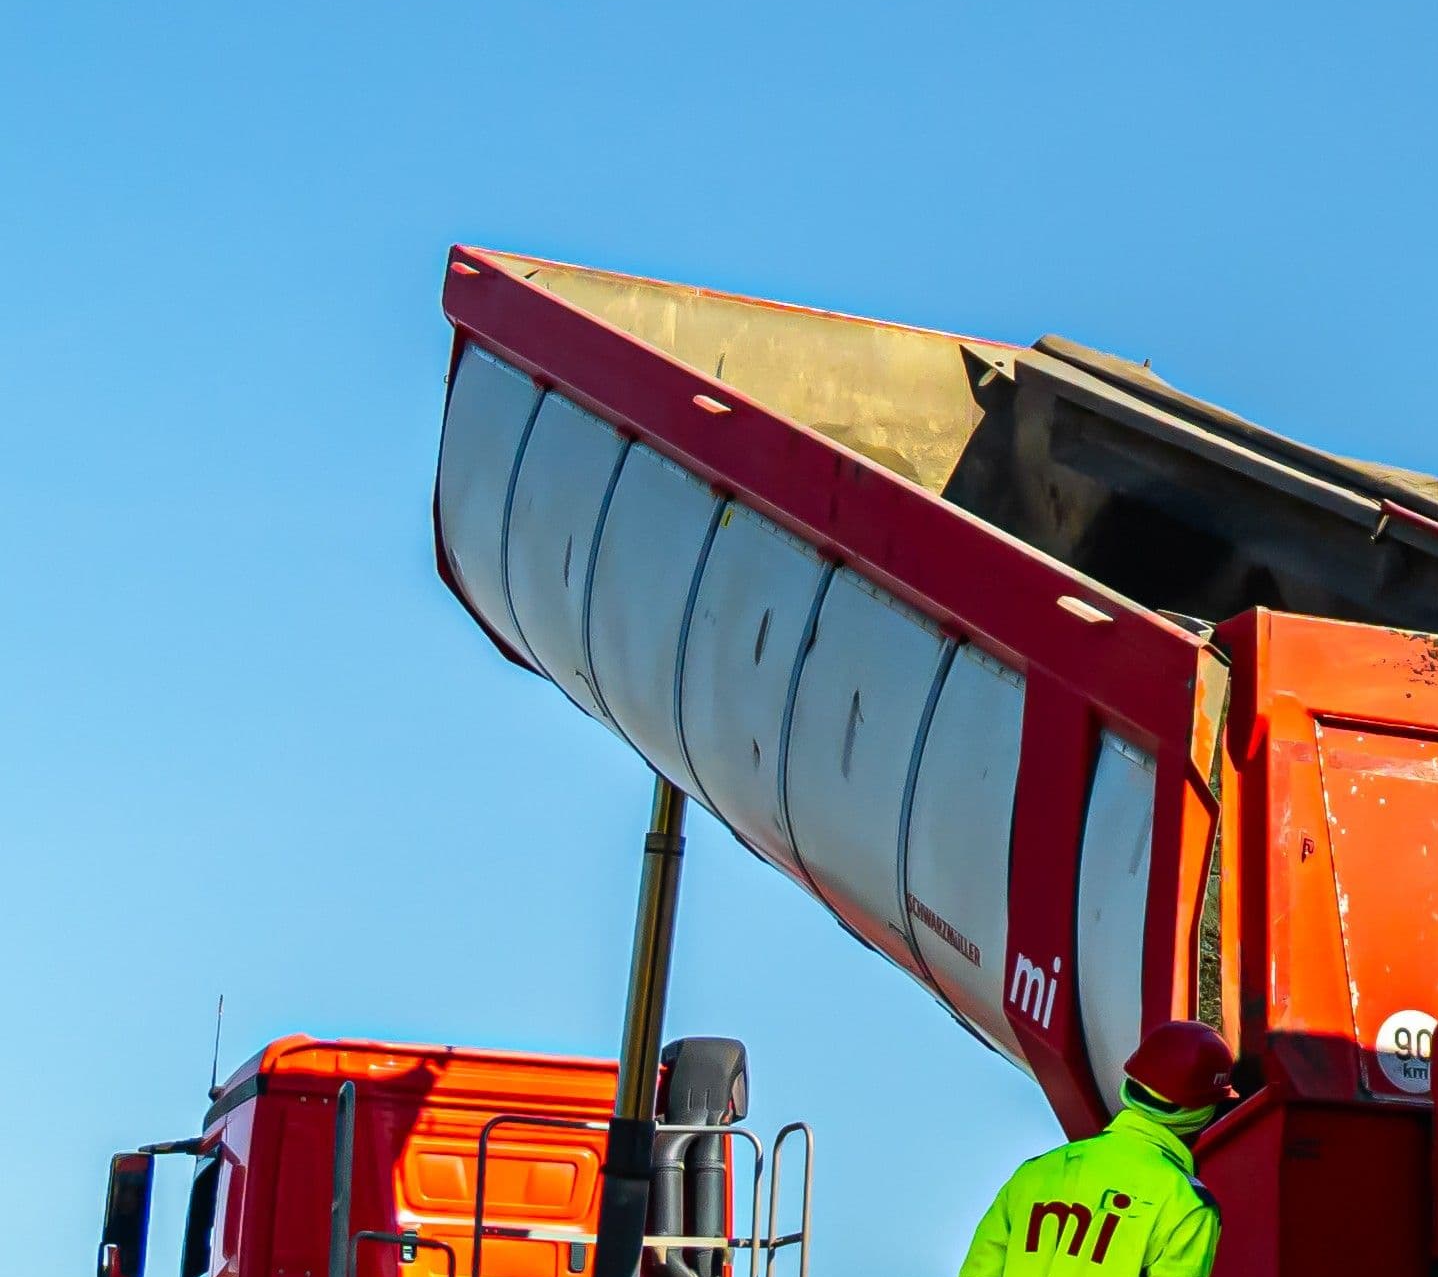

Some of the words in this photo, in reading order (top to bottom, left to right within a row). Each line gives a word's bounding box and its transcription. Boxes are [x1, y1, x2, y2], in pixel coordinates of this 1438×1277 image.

[1010, 953, 1062, 1029] mi
[1395, 1027, 1432, 1062] 90
[1403, 1062, 1429, 1080] km
[1025, 1193, 1131, 1264] mi
